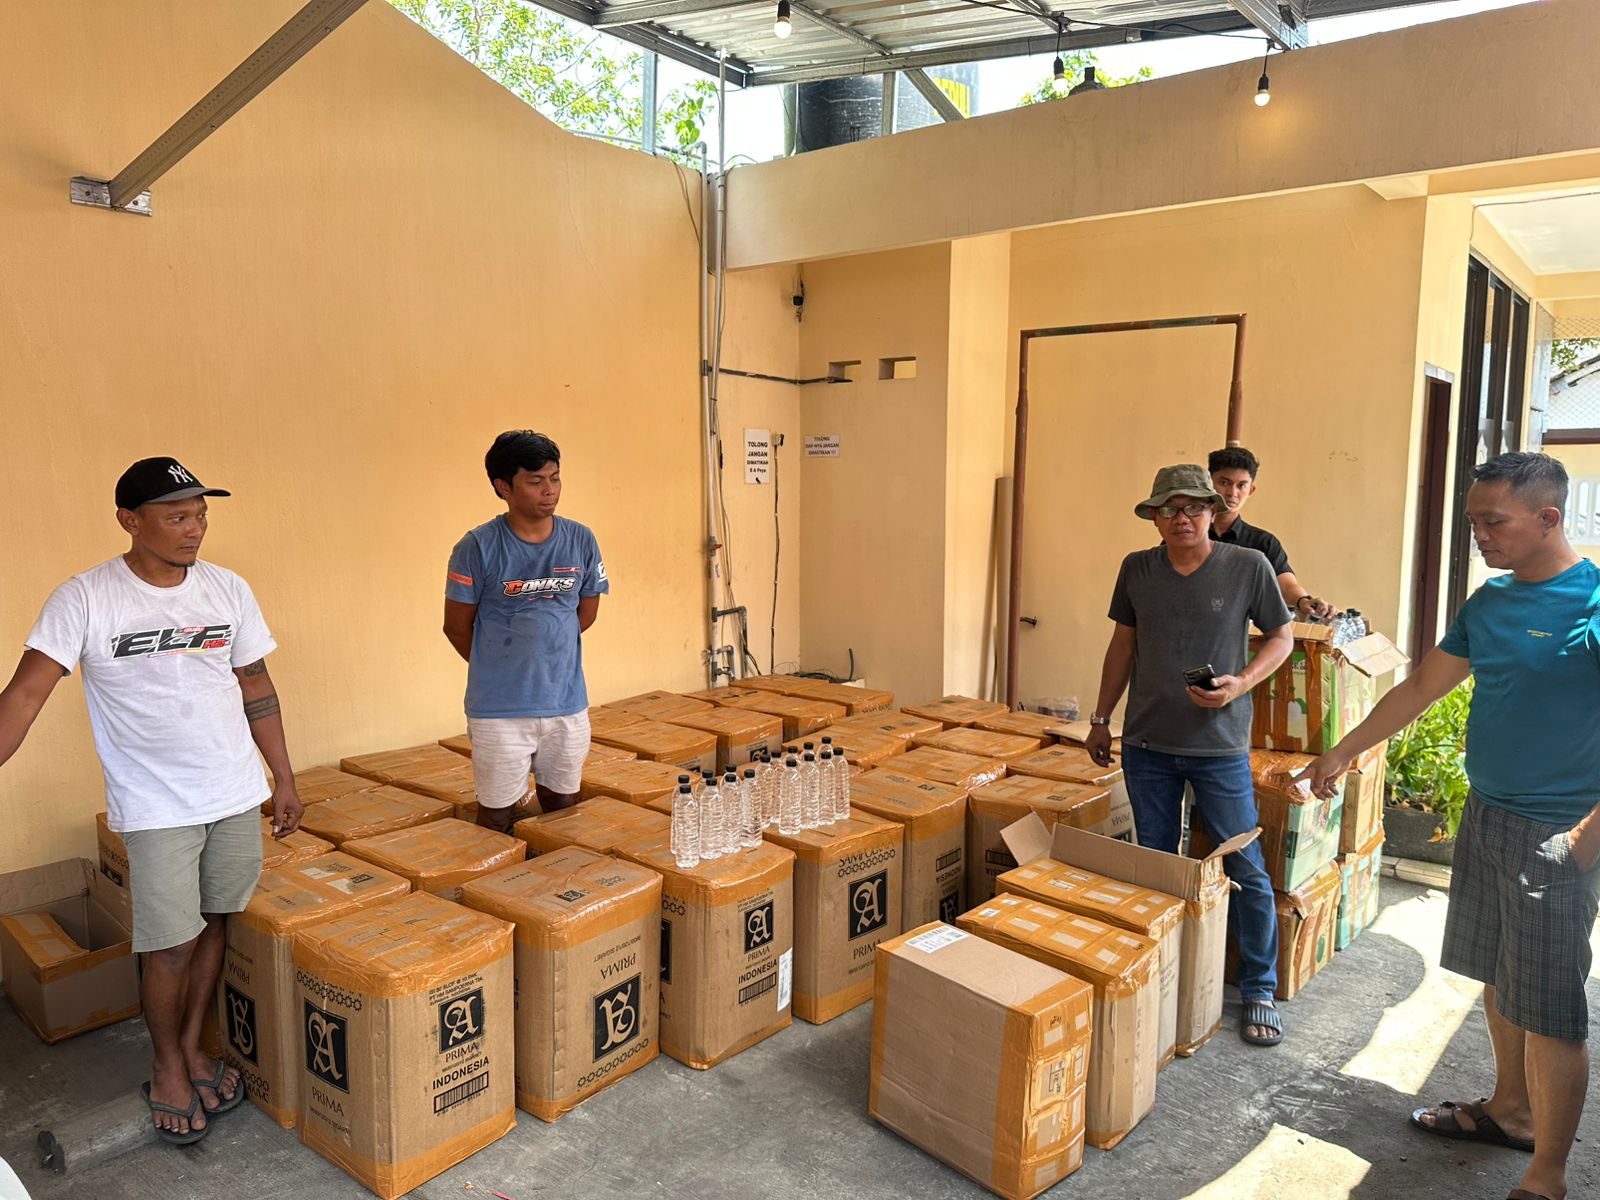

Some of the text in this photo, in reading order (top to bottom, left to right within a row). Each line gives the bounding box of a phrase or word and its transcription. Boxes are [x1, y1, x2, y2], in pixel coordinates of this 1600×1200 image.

[168, 465, 193, 483] NY
[503, 577, 577, 597] CONK'S
[112, 624, 231, 658] ELF
[600, 952, 636, 980] PRIMA
[747, 946, 771, 963] PRIMA
[228, 959, 250, 985] PRIMA
[738, 959, 778, 984] INDONESIA
[445, 1041, 479, 1063] PRIMA
[432, 1056, 490, 1090] INDONESIA
[311, 1086, 345, 1117] PRIMA
